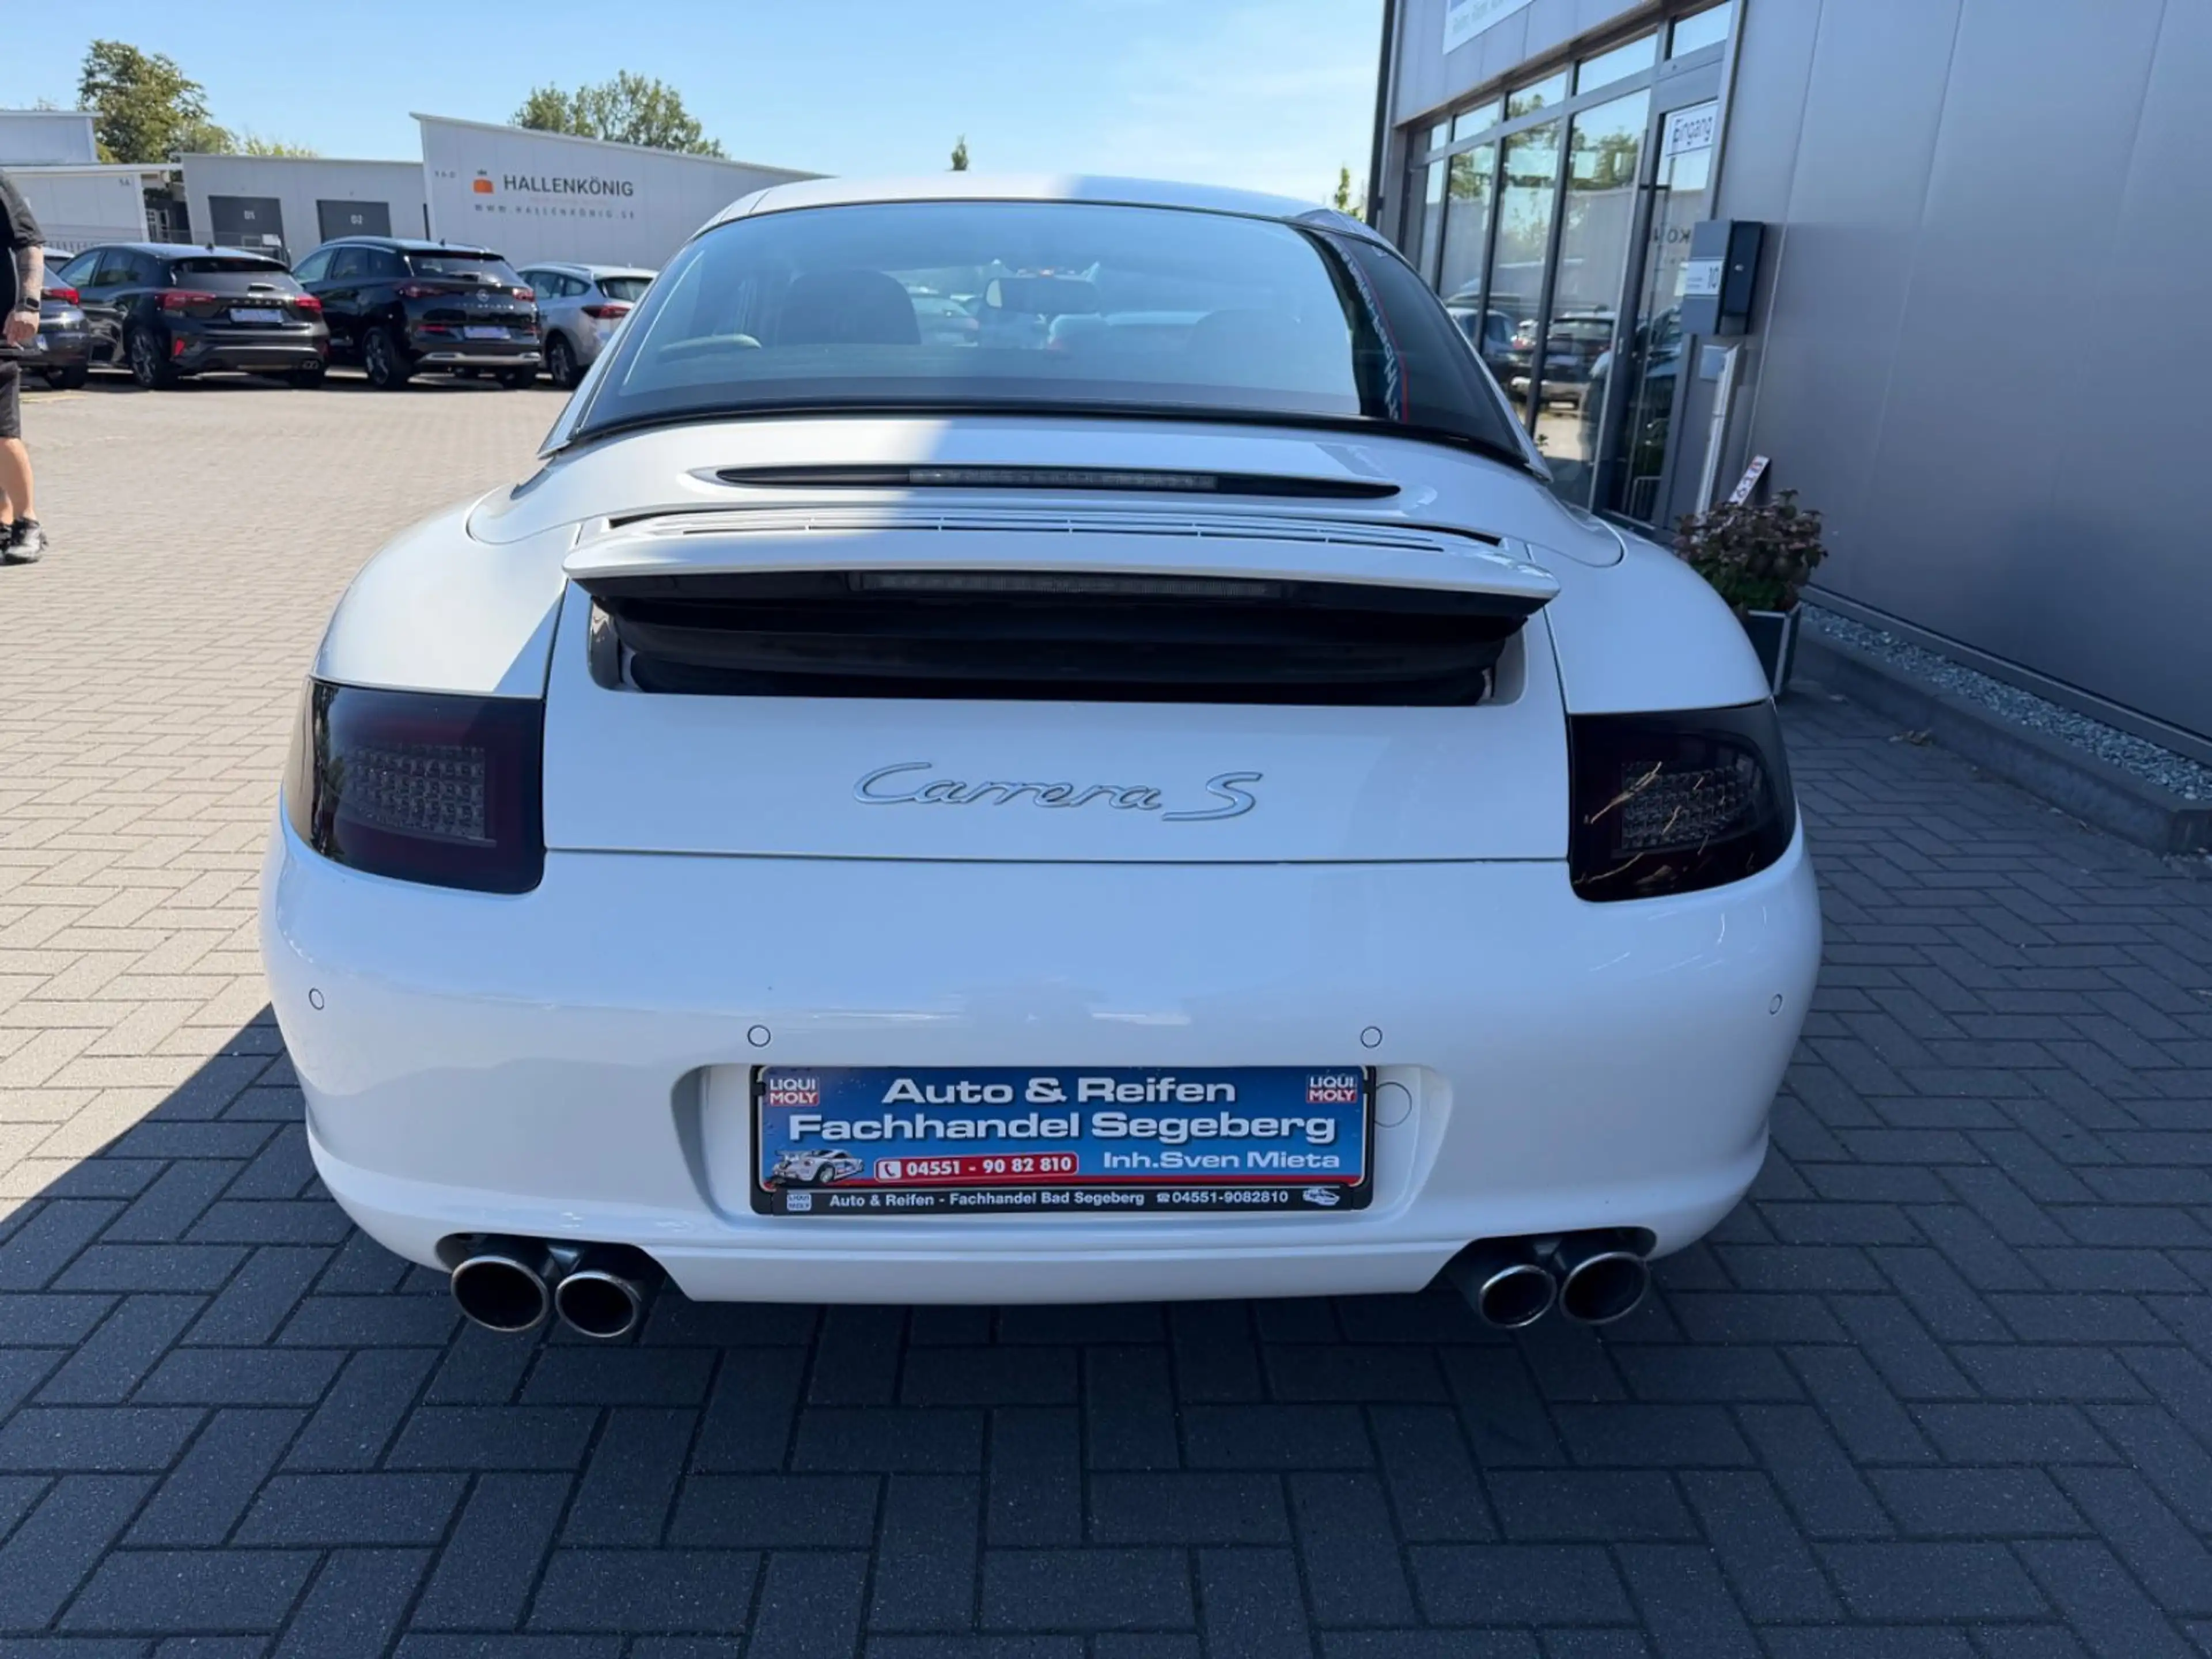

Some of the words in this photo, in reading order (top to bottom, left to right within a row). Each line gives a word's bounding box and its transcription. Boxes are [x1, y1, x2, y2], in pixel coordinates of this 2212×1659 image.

[1673, 116, 1713, 146] Eingang
[503, 175, 634, 196] HALLENKÖNIG
[853, 762, 1162, 810] Carrera
[1161, 772, 1263, 821] S
[770, 1079, 816, 1090] LIQUI
[881, 1078, 1013, 1103] Auto
[1025, 1077, 1067, 1103] &
[1078, 1077, 1236, 1103] Reifen
[1309, 1076, 1354, 1089] LIQUI
[770, 1092, 818, 1104] MOLY
[1308, 1090, 1355, 1101] MOLY
[789, 1112, 1080, 1141] Fachhandel
[1092, 1112, 1335, 1145] Segeberg
[906, 1159, 960, 1176] 04551
[983, 1158, 1005, 1173] 90
[1012, 1158, 1033, 1173] 82
[1040, 1157, 1071, 1172] 810
[1247, 1151, 1340, 1168] Mieta
[830, 1195, 865, 1207] Auto
[870, 1194, 881, 1206] &
[886, 1194, 934, 1206] Reifen
[949, 1192, 1037, 1205] Fachhandel
[1041, 1192, 1069, 1204] Bad
[1074, 1192, 1145, 1206] Segeberg
